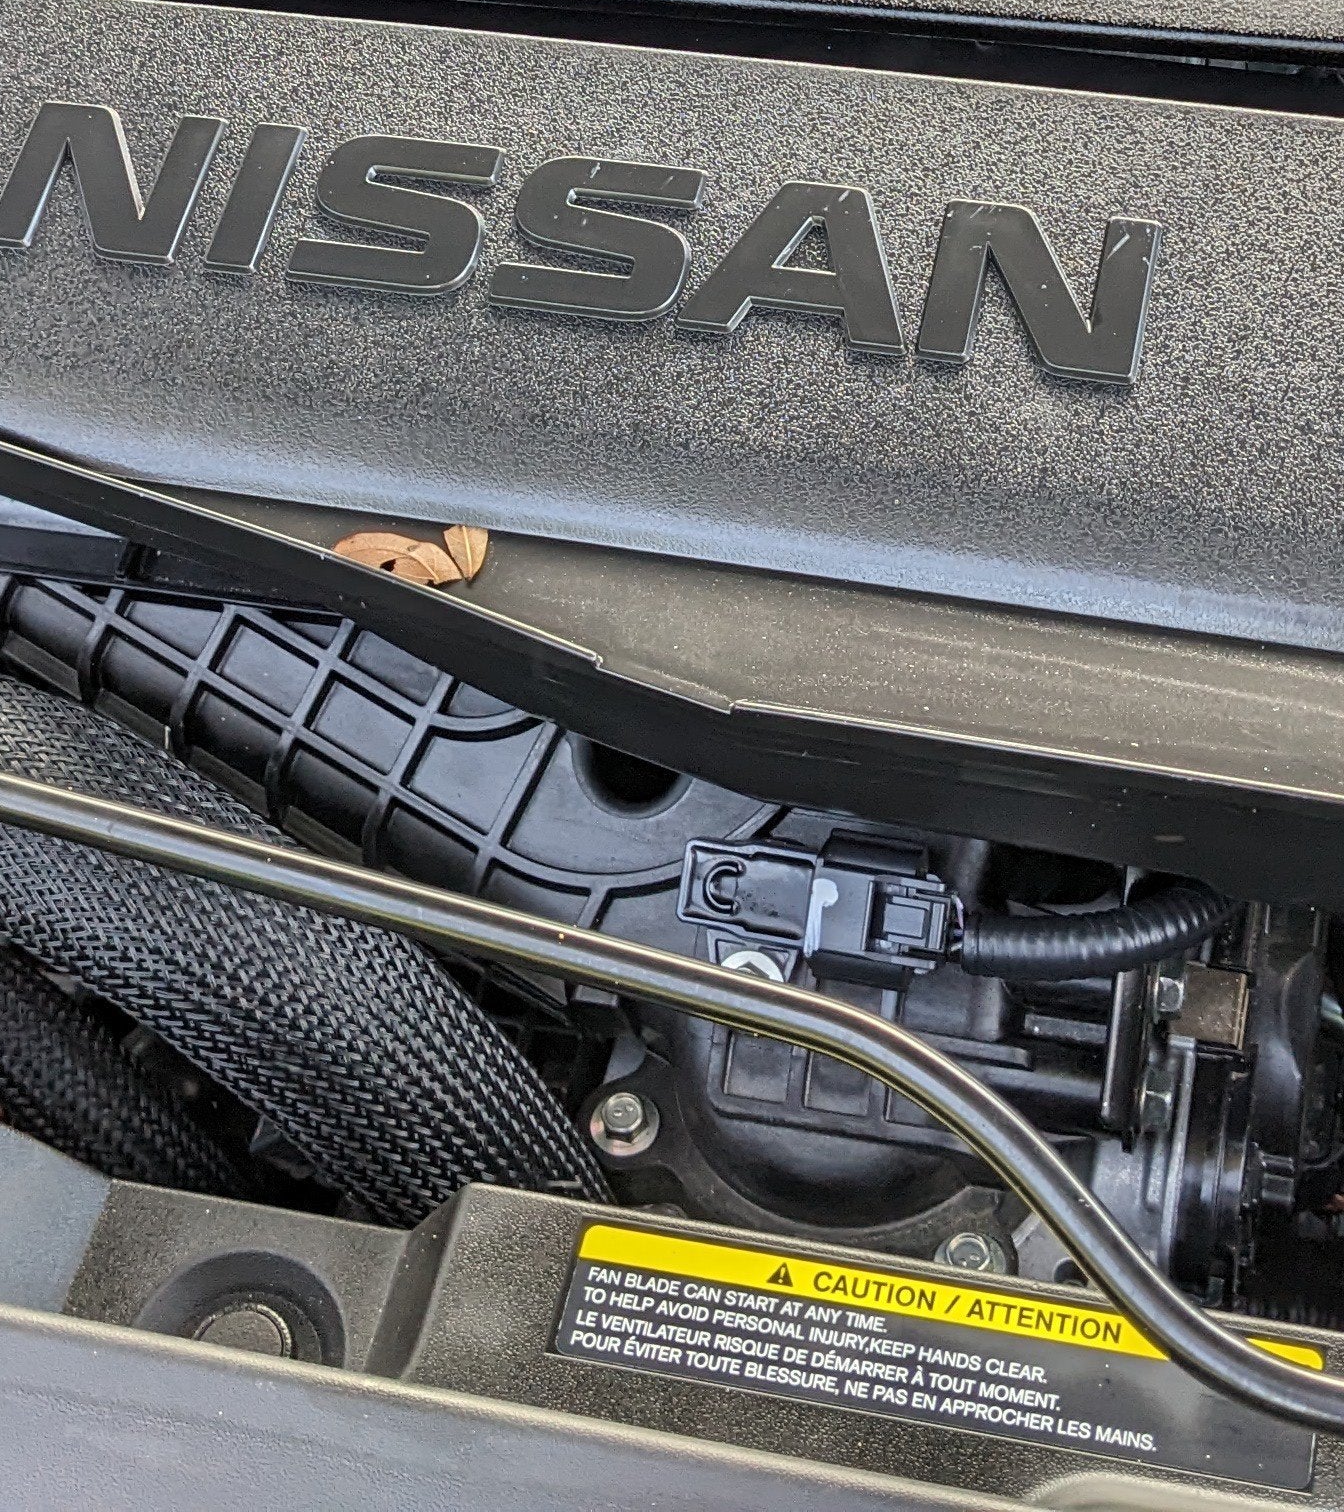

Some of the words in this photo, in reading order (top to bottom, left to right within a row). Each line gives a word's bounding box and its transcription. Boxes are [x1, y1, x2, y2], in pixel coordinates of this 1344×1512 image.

[584, 1287, 606, 1304] TO
[610, 1292, 654, 1313] HELP
[656, 1301, 709, 1321] AVOID
[713, 1311, 804, 1340] PERSONAL
[918, 1348, 981, 1371] HANDS
[985, 1358, 1047, 1384] CLEAR.
[587, 1266, 622, 1285] FAN
[625, 1272, 680, 1296] BLADE
[683, 1284, 721, 1303] CAN
[724, 1291, 778, 1314] START
[781, 1302, 802, 1316] AT
[804, 1305, 842, 1324] ANY
[845, 1314, 887, 1333] TIME.
[813, 1271, 936, 1311] CAUTION
[966, 1299, 1122, 1344] ATTENTION
[570, 1330, 619, 1352] POUR
[623, 1335, 682, 1365] ÉVITER
[685, 1350, 741, 1375] TOUTE
[743, 1363, 840, 1396] BLESSURE,
[844, 1377, 869, 1400] NE
[873, 1386, 908, 1406] PAS
[911, 1392, 936, 1411] EN
[940, 1397, 1052, 1433] APPROCHER
[1056, 1418, 1091, 1440] LES
[1095, 1425, 1157, 1452] MAINS.
[576, 1311, 597, 1327] LE
[601, 1314, 710, 1347] VENTILATEUR
[714, 1334, 779, 1359] RISQUE
[783, 1347, 806, 1364] DE
[810, 1350, 907, 1384] DÉMARRER
[911, 1366, 924, 1386] À
[929, 1373, 974, 1396] TOUT
[977, 1382, 1061, 1411] MOMENT.
